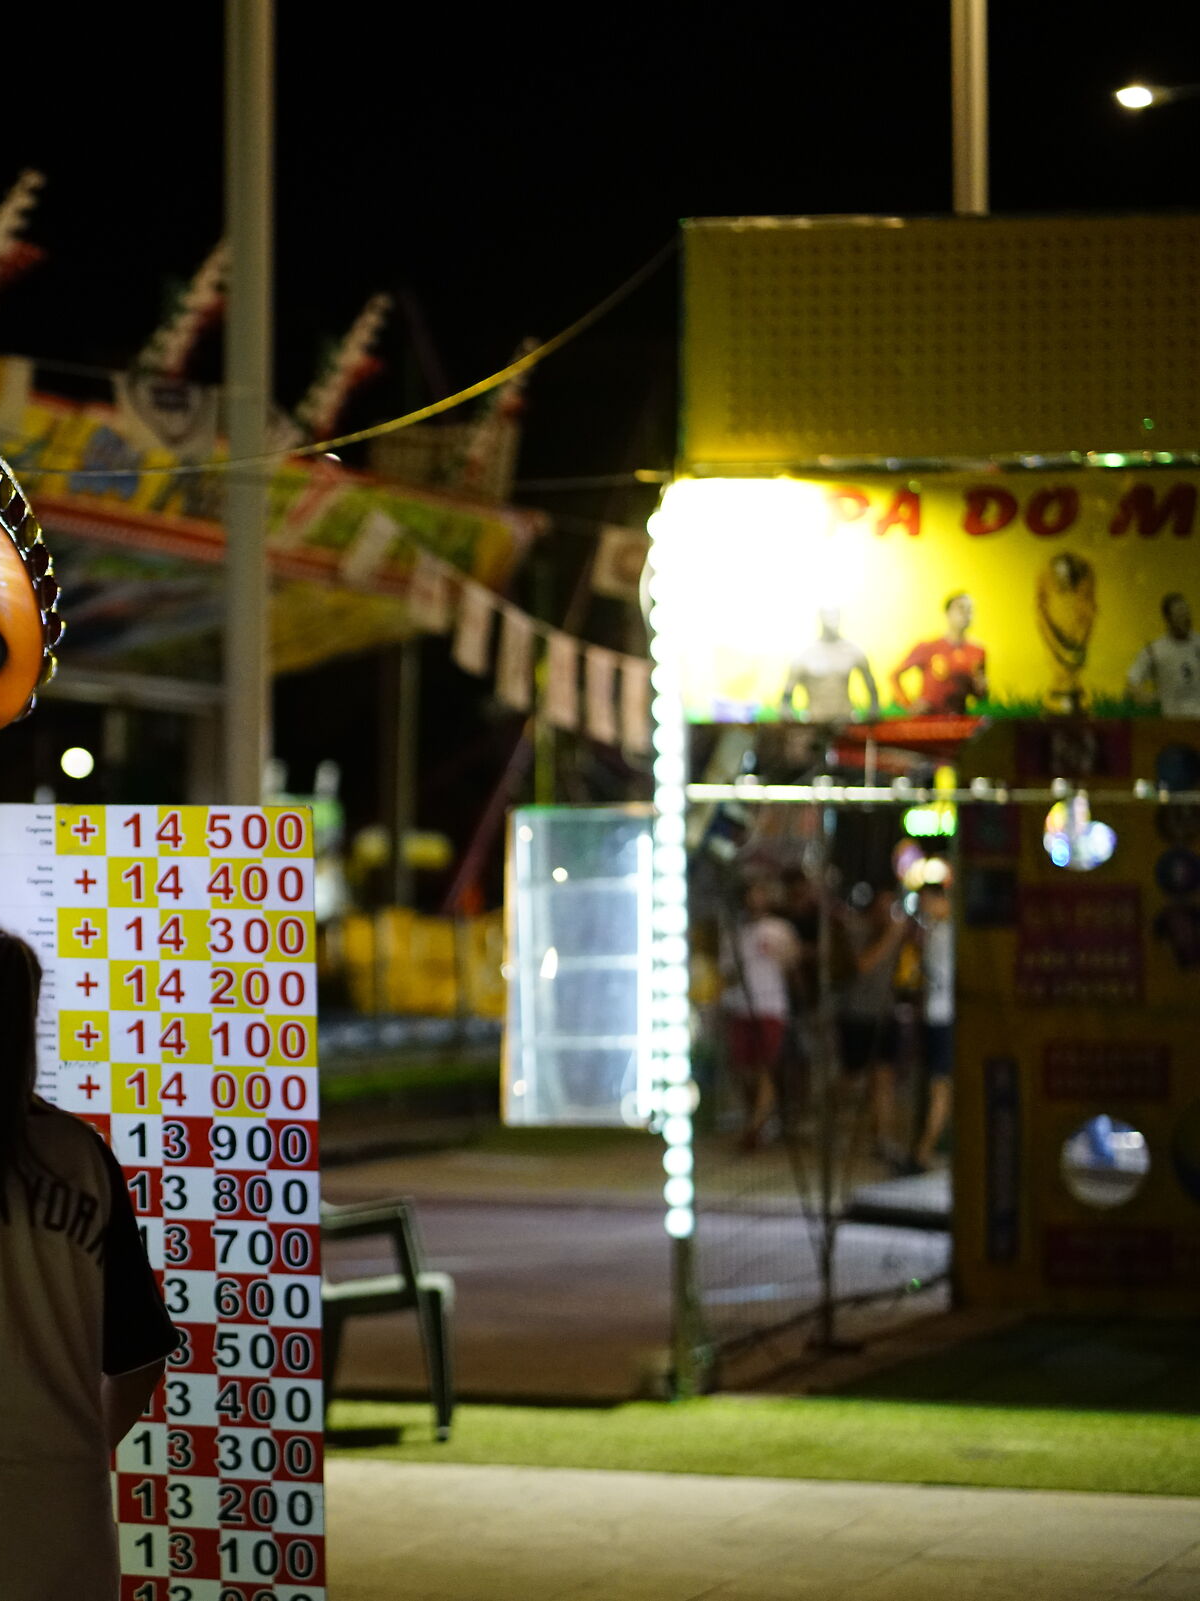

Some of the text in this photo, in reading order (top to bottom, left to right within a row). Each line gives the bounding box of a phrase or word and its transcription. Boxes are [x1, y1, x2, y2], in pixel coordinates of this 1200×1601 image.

[962, 484, 1079, 537] DO
[73, 813, 302, 850] + 14 500
[74, 864, 303, 902] + 14 400
[74, 916, 304, 954] + 14 300
[76, 967, 306, 1006] + 14 200
[77, 1019, 306, 1059] + 14 100
[78, 1071, 306, 1111] + 14 000
[128, 1123, 307, 1163] 13 900
[128, 1173, 309, 1215] 13 800
[212, 1229, 310, 1268] 700
[166, 1277, 310, 1319] 3 600
[167, 1331, 311, 1371] 3 500
[215, 1382, 312, 1423] 400
[133, 1430, 312, 1475] 13 300
[133, 1482, 313, 1526] 13 200
[135, 1533, 315, 1578] 13 100
